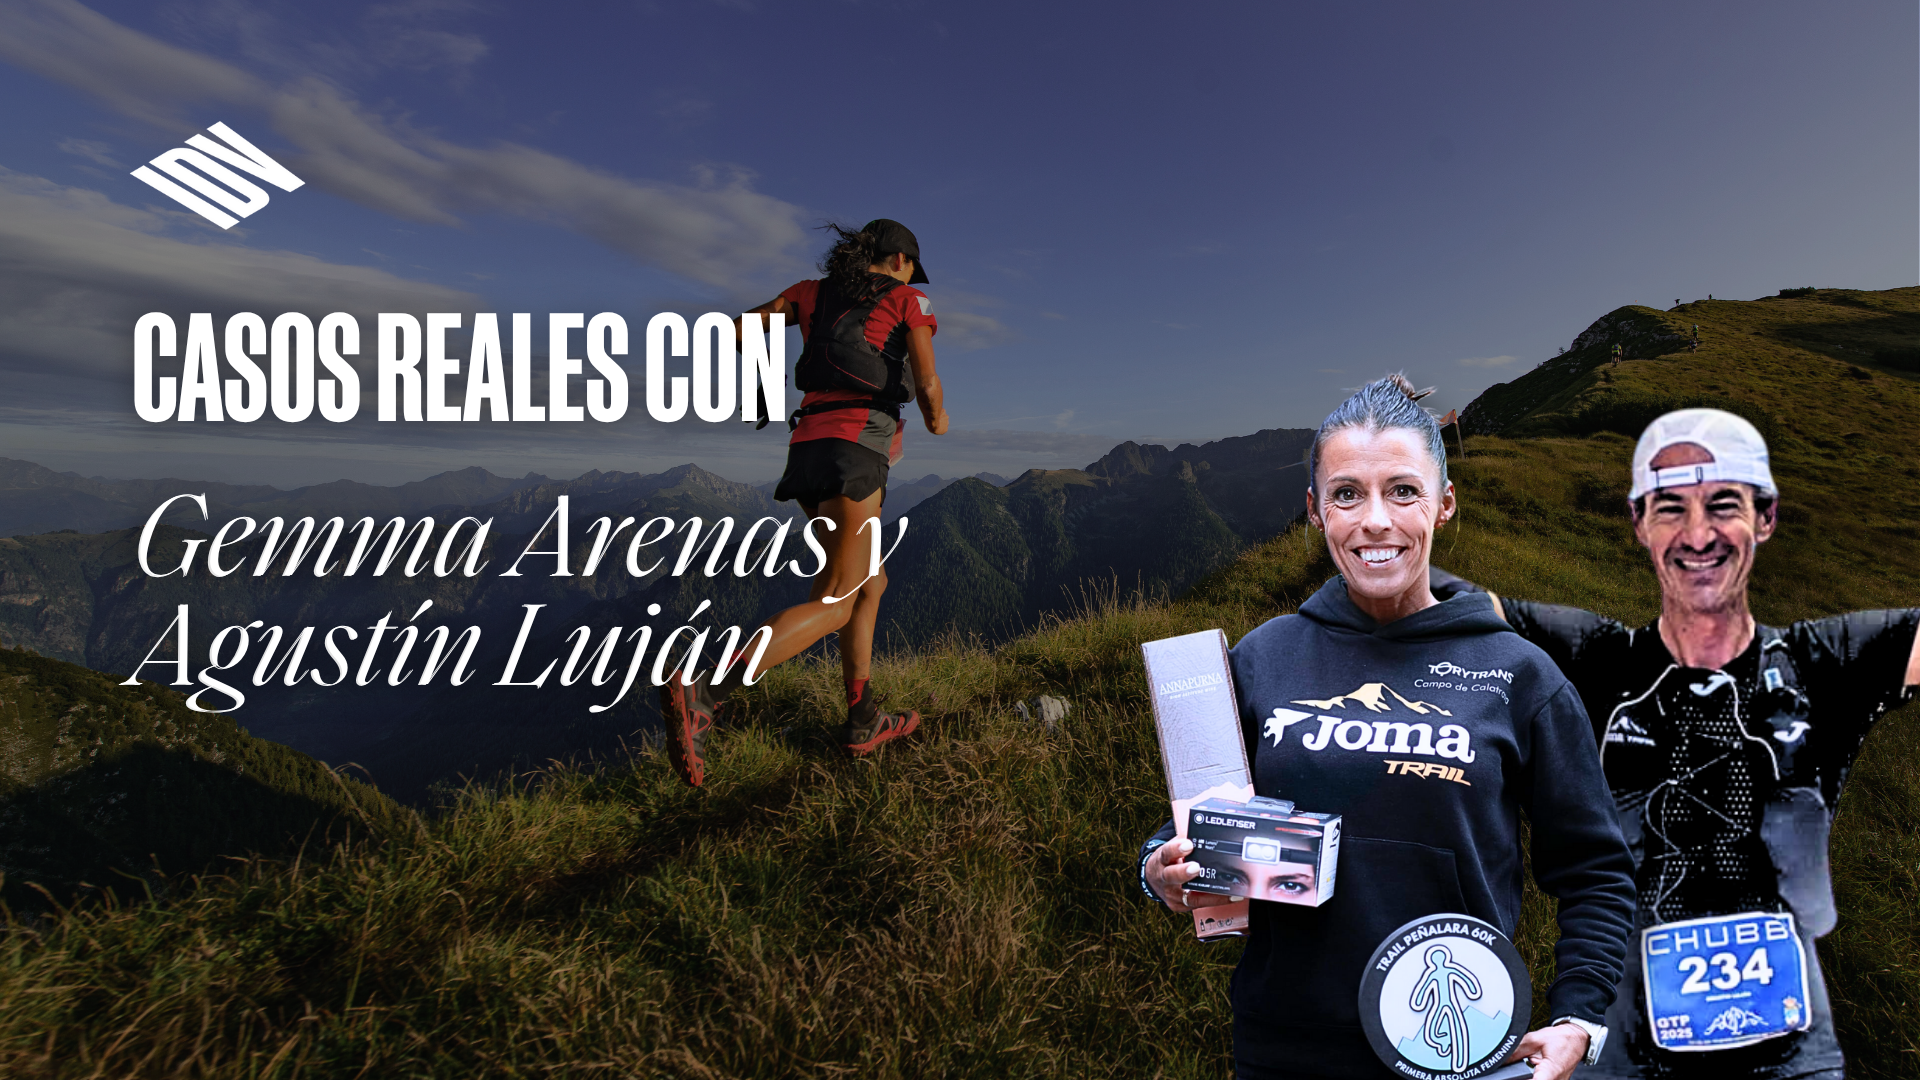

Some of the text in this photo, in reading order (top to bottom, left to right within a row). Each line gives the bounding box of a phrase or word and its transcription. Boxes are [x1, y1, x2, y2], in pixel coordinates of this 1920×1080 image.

[1160, 672, 1223, 695] ANNAPURNA
[1414, 678, 1452, 690] Campo
[1454, 683, 1468, 692] de
[1428, 661, 1514, 685] TORYTRANS
[1302, 714, 1476, 764] Joma
[1383, 759, 1472, 787] TRAIL
[1205, 815, 1256, 830] LEDLENSER
[1376, 922, 1497, 972] TRAIL PEÑALARA 60K
[1648, 920, 1788, 956] CHUBB
[1678, 947, 1774, 995] 234
[1660, 1027, 1693, 1040] 2025
[1395, 1034, 1517, 1080] PRIMERA ABSOLUTA FEMENINA
